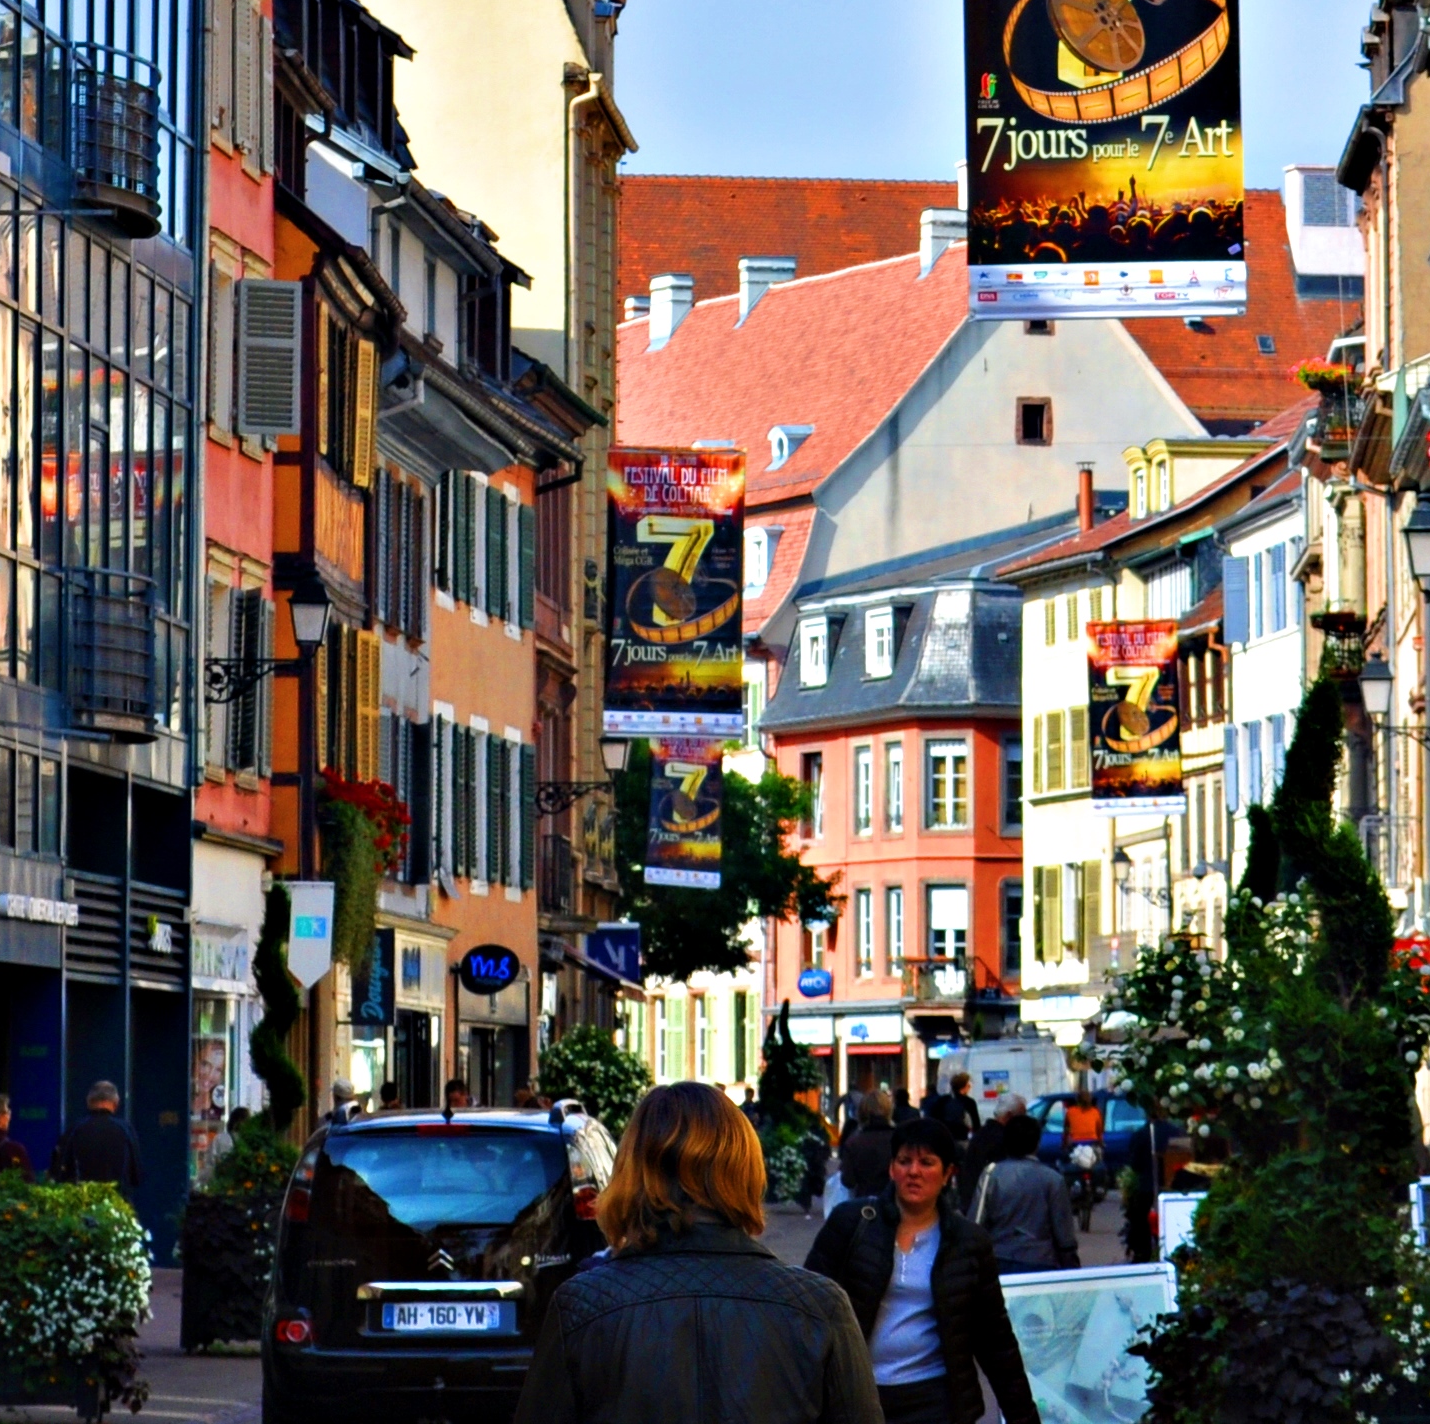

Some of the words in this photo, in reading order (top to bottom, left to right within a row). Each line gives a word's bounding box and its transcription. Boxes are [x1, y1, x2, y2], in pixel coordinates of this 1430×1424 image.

[977, 117, 1005, 173] 7
[1003, 117, 1088, 171] jours
[1092, 143, 1126, 162] pour
[1126, 139, 1139, 157] le
[1178, 117, 1235, 158] Art
[623, 466, 677, 485] FESTIVAL
[680, 467, 697, 485] DU
[700, 468, 728, 485] FILM
[643, 485, 658, 502] DE
[662, 484, 711, 503] COLMAR
[610, 639, 626, 667] 7
[624, 639, 667, 665] jours
[711, 641, 739, 664] Art
[1093, 750, 1105, 770] 7
